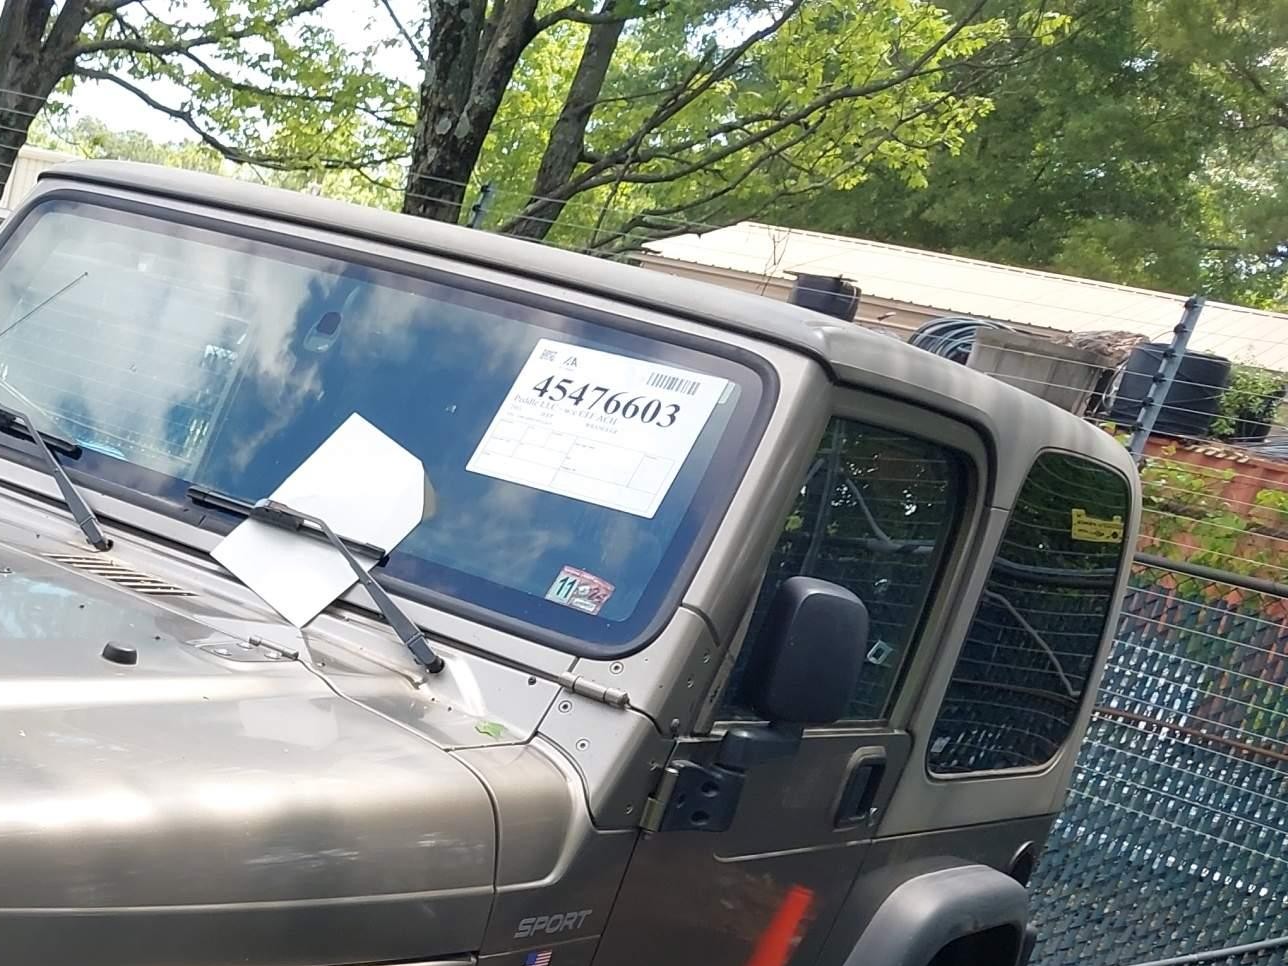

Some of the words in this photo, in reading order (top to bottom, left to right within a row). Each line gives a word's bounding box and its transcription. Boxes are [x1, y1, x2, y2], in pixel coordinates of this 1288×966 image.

[532, 375, 681, 427] 45476603
[556, 576, 577, 599] 11
[513, 909, 593, 938] SPORT
